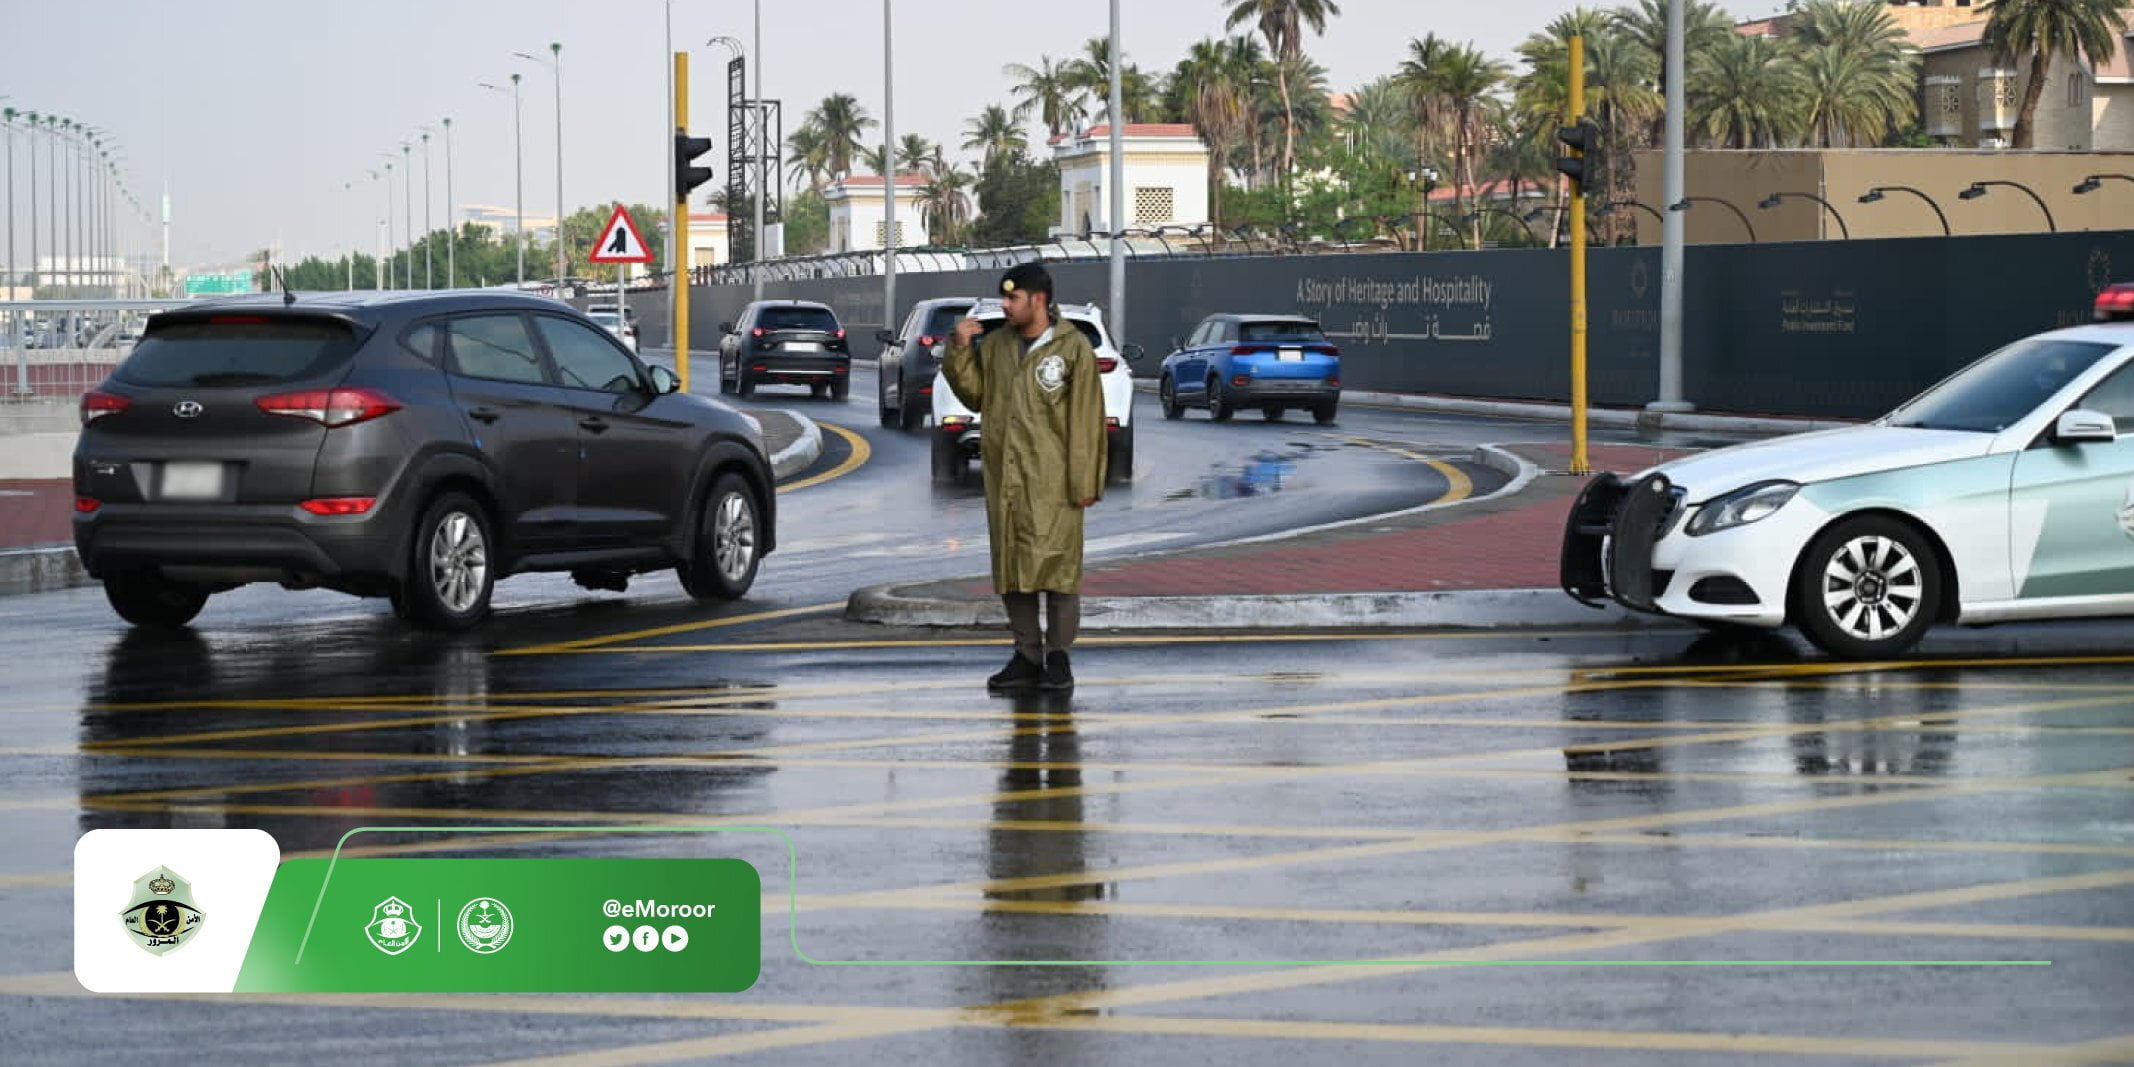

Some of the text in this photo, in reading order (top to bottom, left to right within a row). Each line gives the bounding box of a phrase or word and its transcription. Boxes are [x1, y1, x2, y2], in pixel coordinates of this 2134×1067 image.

[1296, 274, 1491, 311] A Story of Heritage and Hospitality
